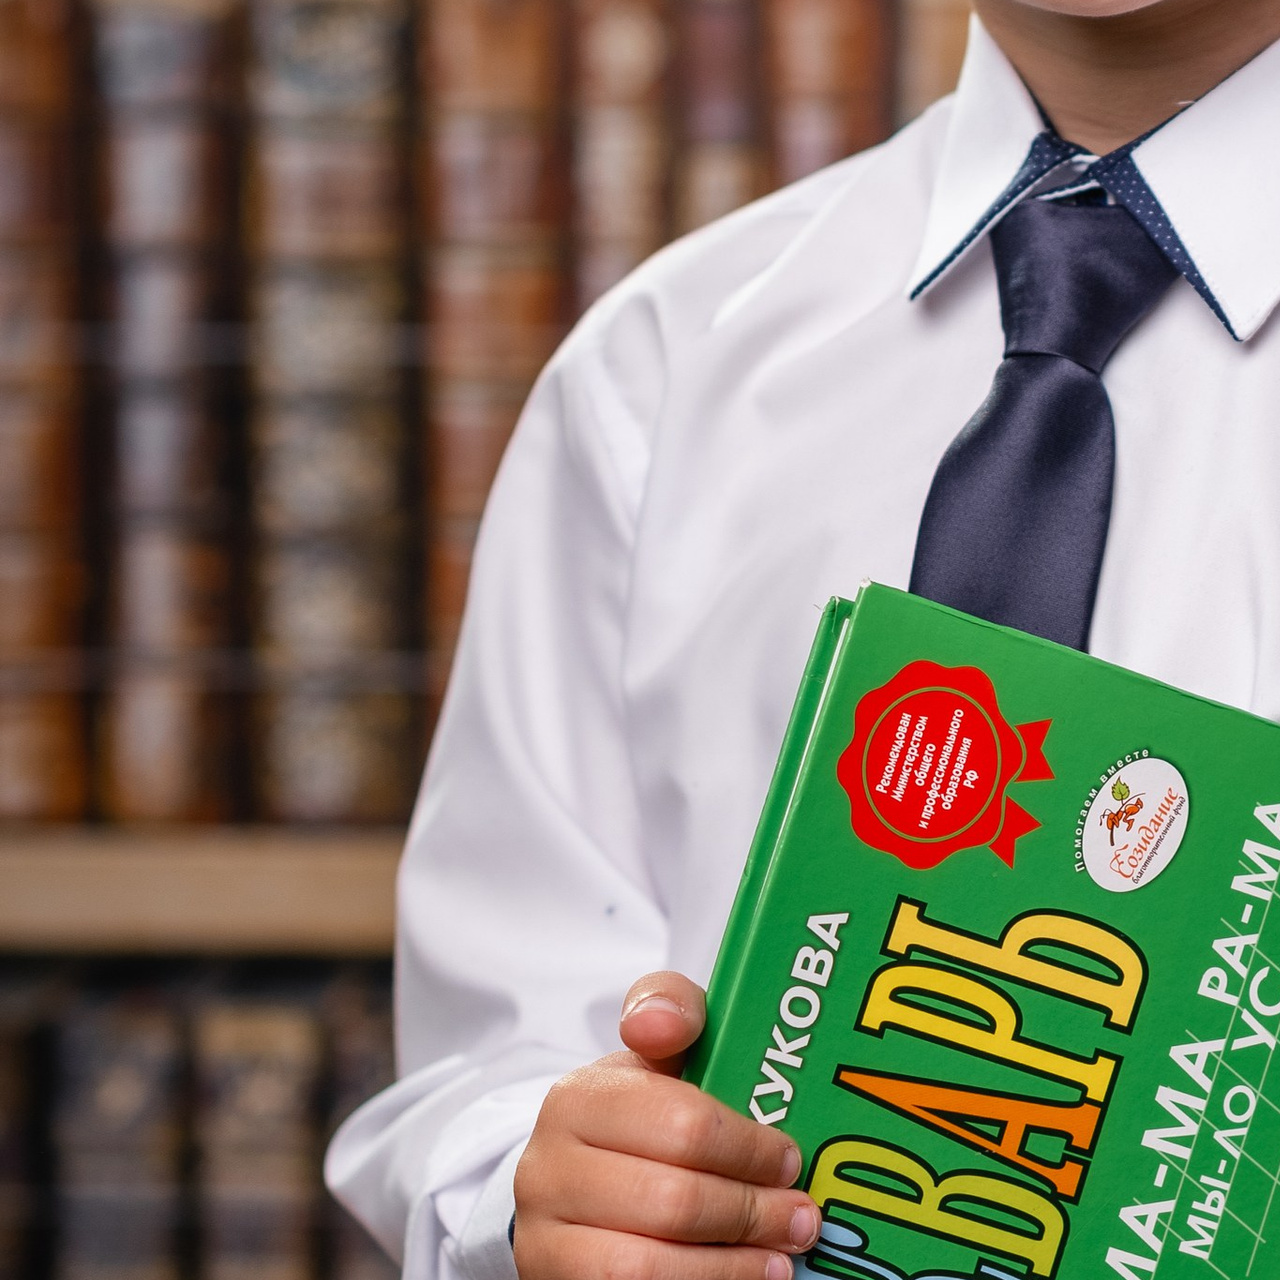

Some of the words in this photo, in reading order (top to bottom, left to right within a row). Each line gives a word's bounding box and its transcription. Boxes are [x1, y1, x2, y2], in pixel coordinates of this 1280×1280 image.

[875, 712, 912, 794] Рекомендован
[891, 715, 929, 802] Министерством
[915, 743, 936, 787] общего
[922, 709, 964, 816] профессионального
[941, 737, 973, 810] образования
[963, 769, 979, 789] РФ
[918, 819, 929, 829] и
[1074, 788, 1099, 873] Помогаем
[1099, 749, 1149, 784] вместе
[1131, 814, 1176, 885] благотворительный
[1173, 796, 1186, 817] фонд
[1178, 1085, 1257, 1261] МЫ-ЛО
